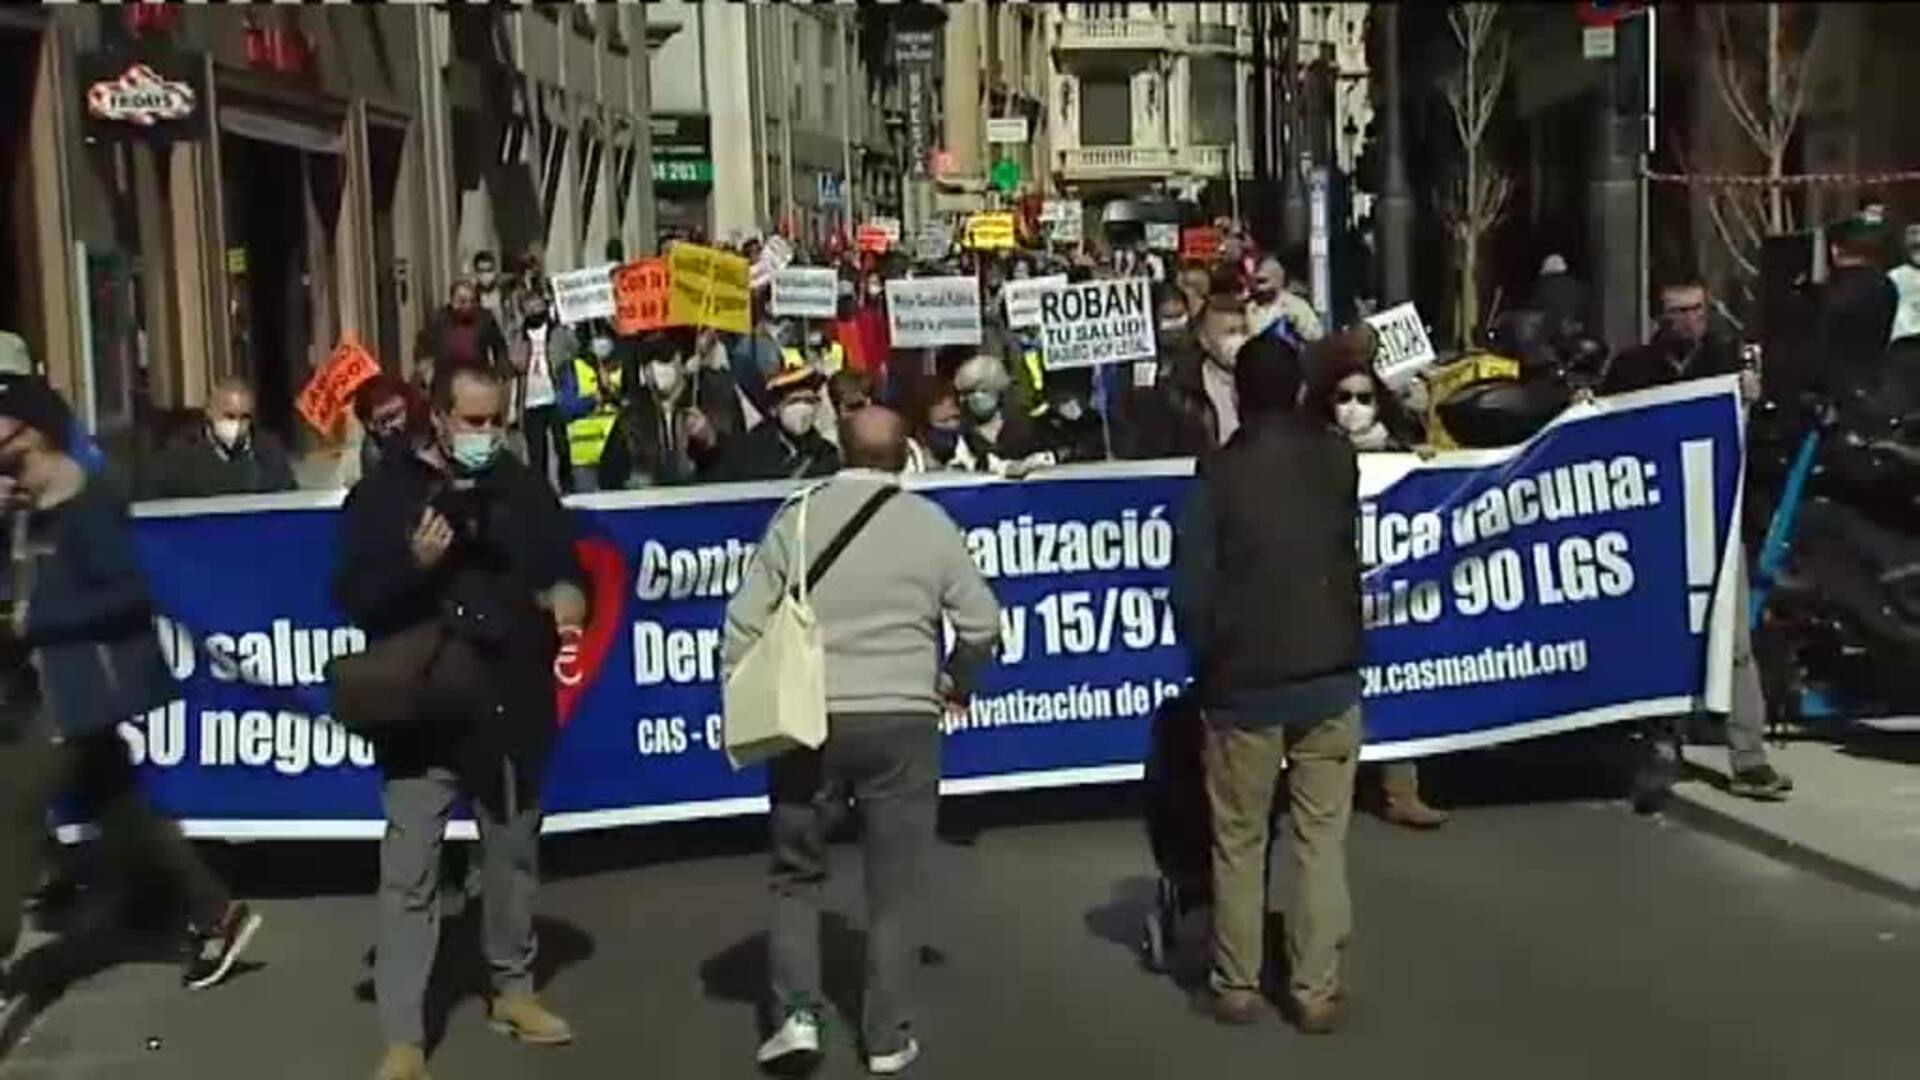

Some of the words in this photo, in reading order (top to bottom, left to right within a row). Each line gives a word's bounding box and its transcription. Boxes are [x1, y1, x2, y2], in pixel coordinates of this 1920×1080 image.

[1041, 282, 1144, 323] ROBAN
[1046, 328, 1071, 345] TU
[961, 504, 1173, 577] atizació
[1356, 502, 1442, 565] ica
[1452, 456, 1661, 547] vacuna:
[152, 615, 196, 682] U
[633, 620, 721, 685] Der
[1035, 586, 1177, 656] 15/97
[1362, 579, 1442, 630] ulo
[1453, 548, 1524, 616] 90
[1533, 531, 1636, 605] LGS
[637, 717, 688, 755] CAS
[938, 682, 1111, 735] privatización
[1115, 681, 1150, 717] de
[1360, 639, 1588, 698] w.casmadrid.org
